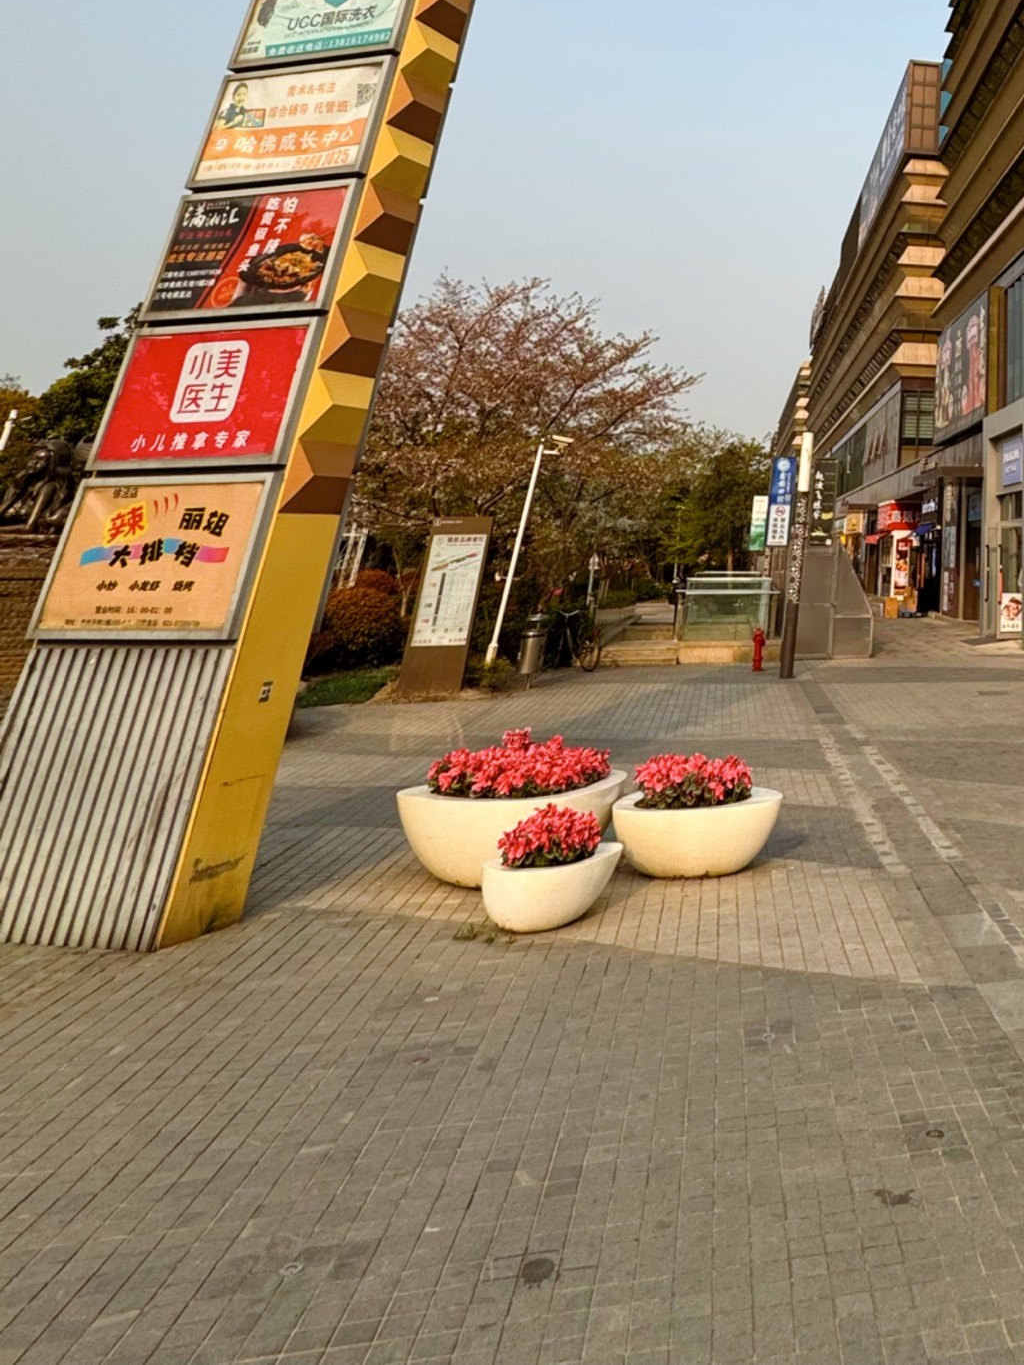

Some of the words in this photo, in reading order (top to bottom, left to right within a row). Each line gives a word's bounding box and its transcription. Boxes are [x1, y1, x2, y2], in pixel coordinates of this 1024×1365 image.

[287, 5, 378, 31] UCC国际洗衣
[233, 128, 353, 154] 哈佛成长中心
[130, 429, 251, 453] 小儿推拿专家
[107, 505, 145, 544] 辣
[178, 506, 230, 537] 丽姐
[109, 537, 201, 568] 大排档
